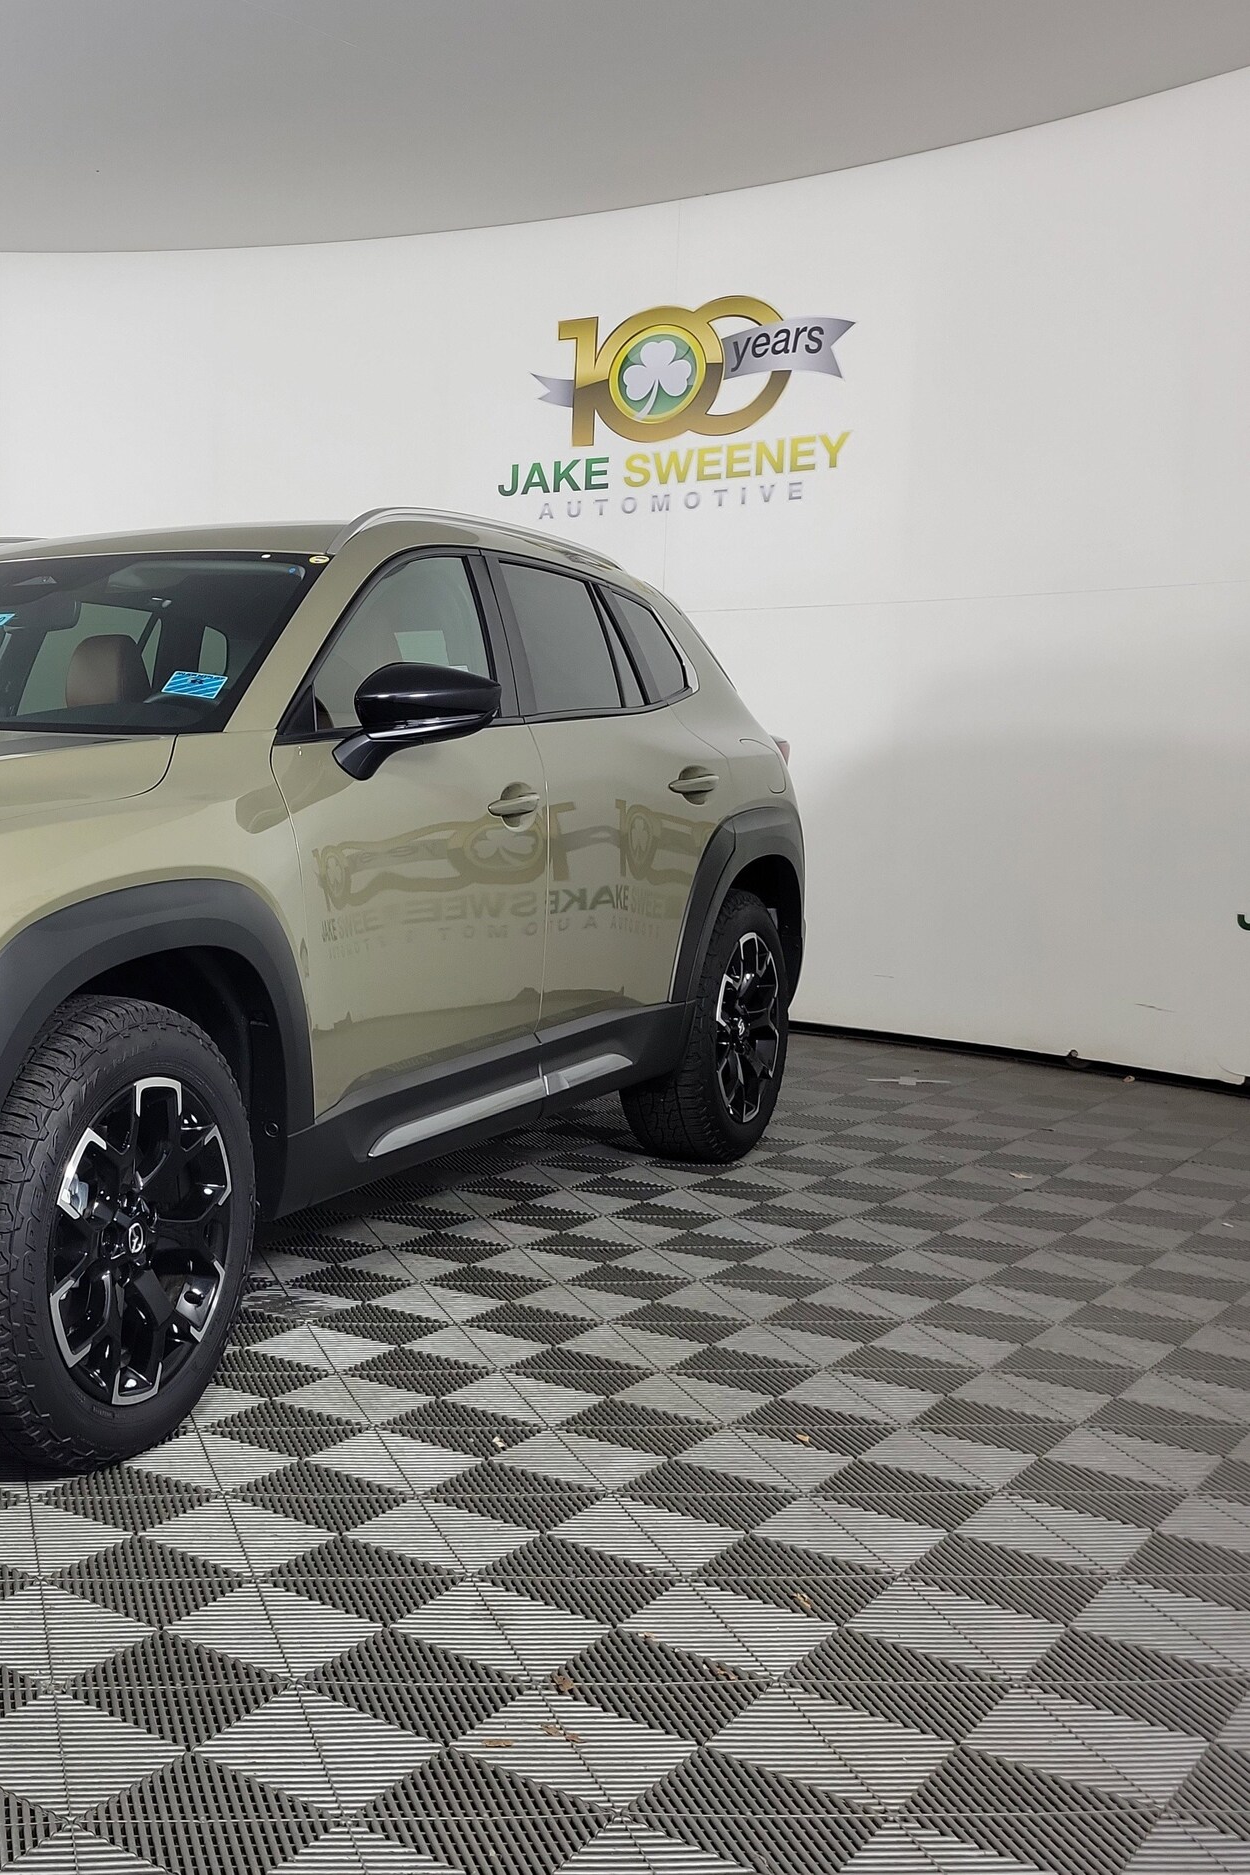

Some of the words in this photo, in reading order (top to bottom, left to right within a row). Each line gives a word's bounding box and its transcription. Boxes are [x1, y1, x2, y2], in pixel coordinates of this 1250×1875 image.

[558, 294, 792, 447] 100
[730, 323, 825, 372] years
[498, 456, 610, 496] JAKE
[623, 429, 853, 488] SWEENEY
[538, 481, 804, 520] AUTOMOTIVE
